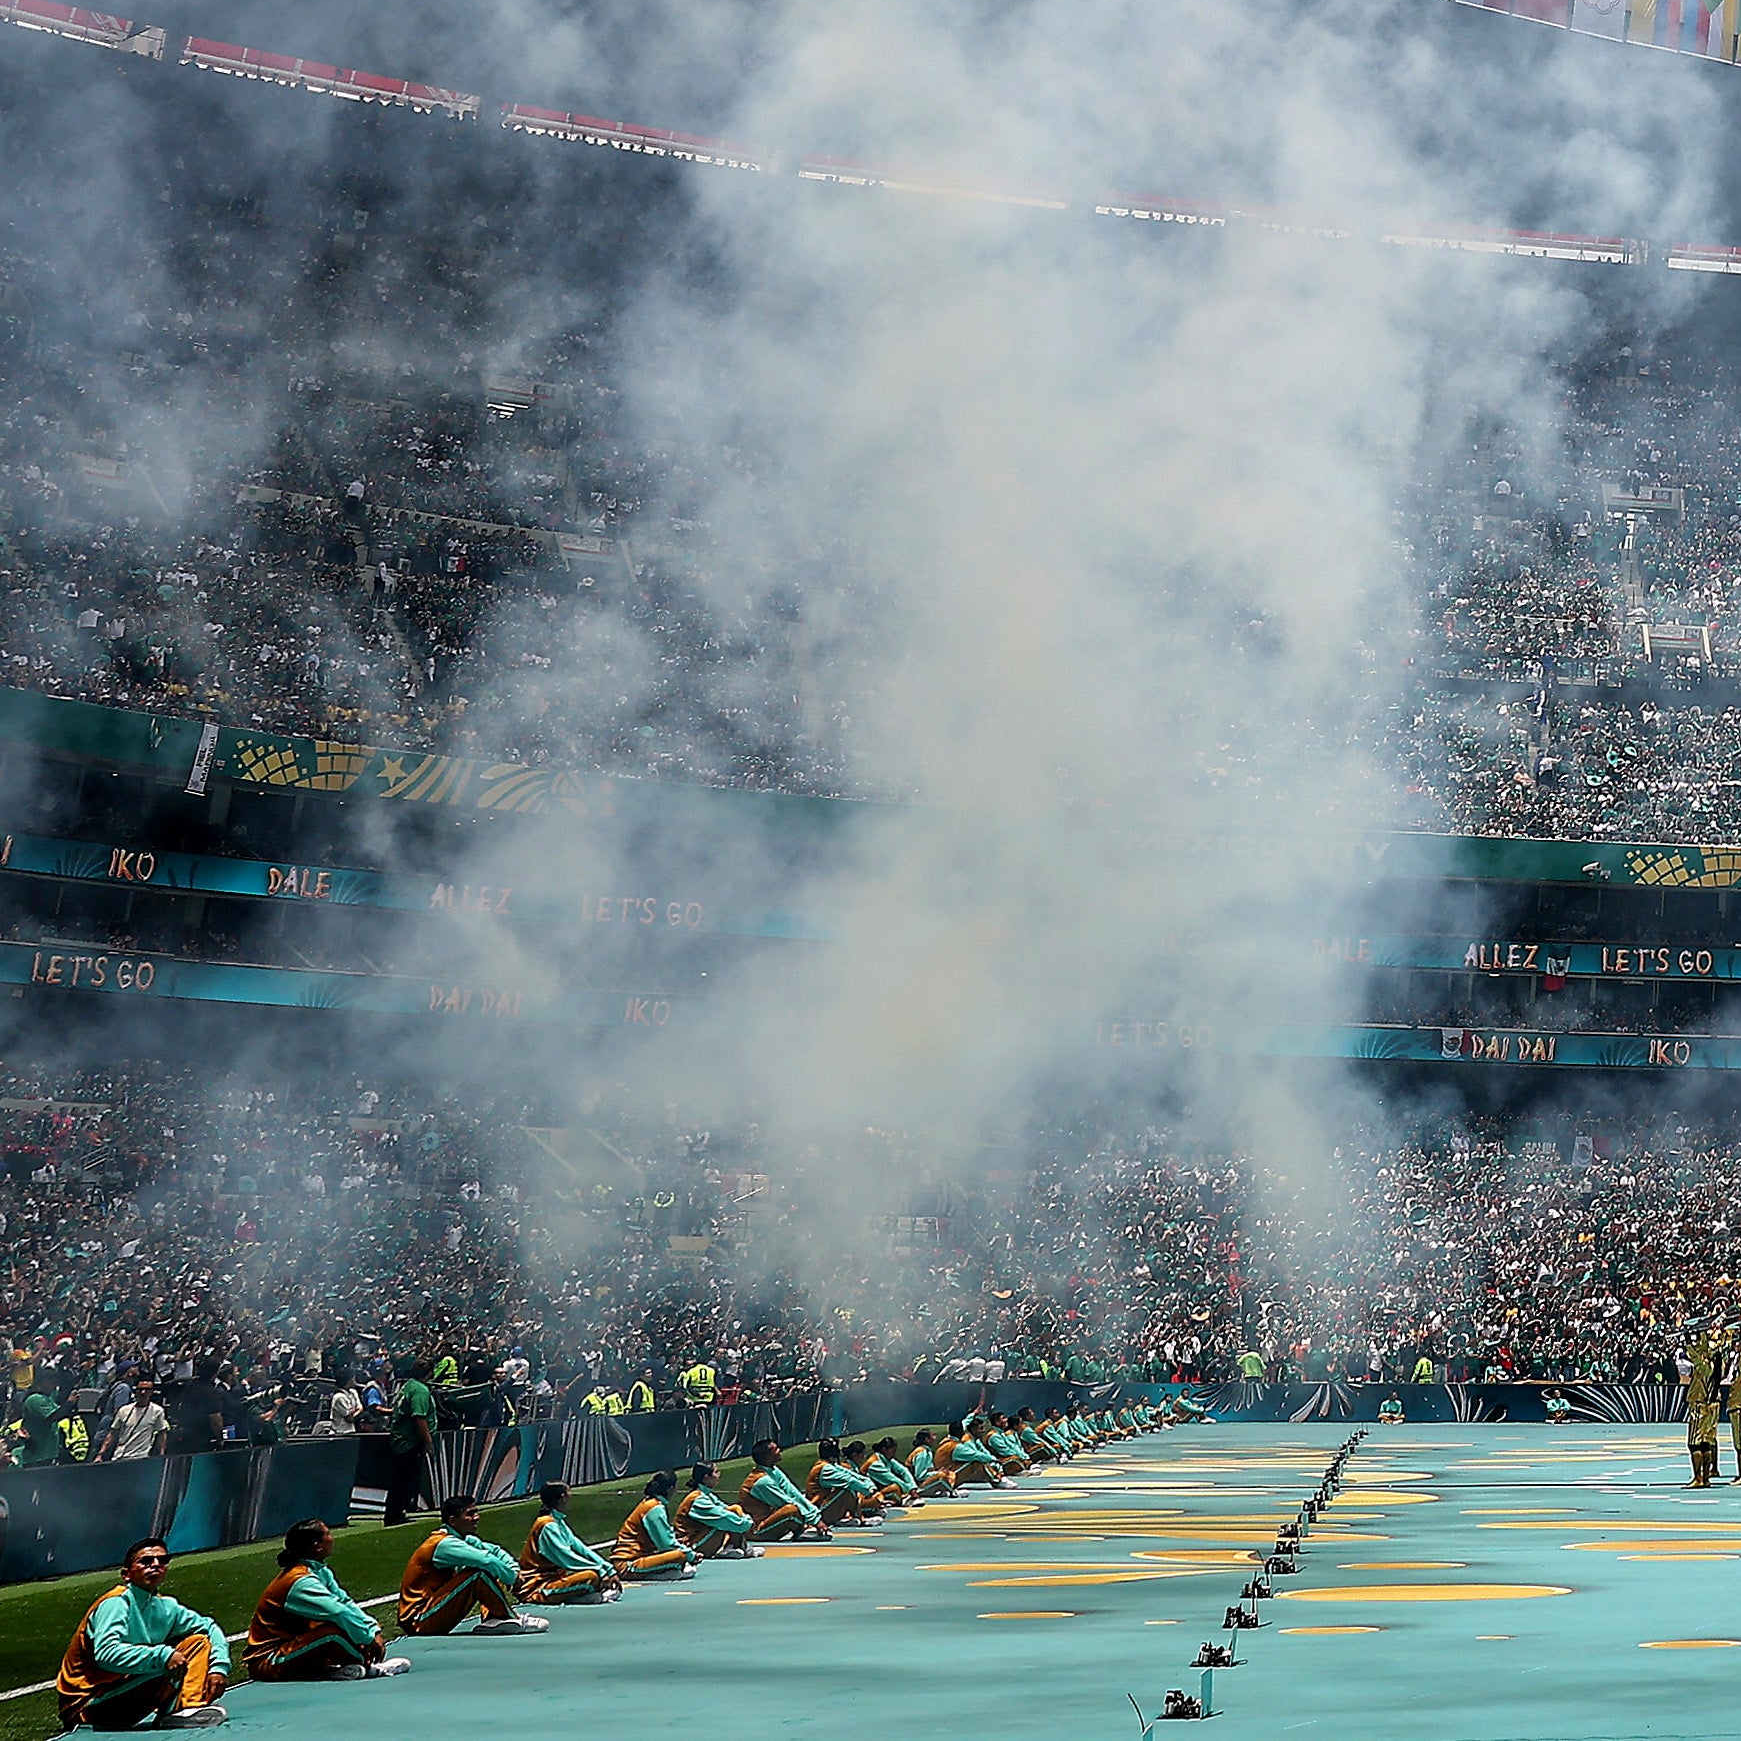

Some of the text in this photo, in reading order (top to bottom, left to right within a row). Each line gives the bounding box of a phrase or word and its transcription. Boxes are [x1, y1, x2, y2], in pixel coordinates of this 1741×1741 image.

[109, 849, 156, 881] IKO
[268, 867, 331, 899] DALE
[431, 883, 511, 915] ALLEZ
[666, 901, 702, 929] GO
[1313, 938, 1372, 962] DALE
[1463, 942, 1538, 971] ALLEZ
[1601, 946, 1713, 975] LET'S GO
[32, 952, 155, 991] LET'S GO
[429, 985, 522, 1018] DAI DAI
[625, 997, 670, 1026] IKO
[1179, 1026, 1213, 1050] GO
[1471, 1034, 1556, 1062] DAI DAI
[1648, 1039, 1690, 1064] IKO
